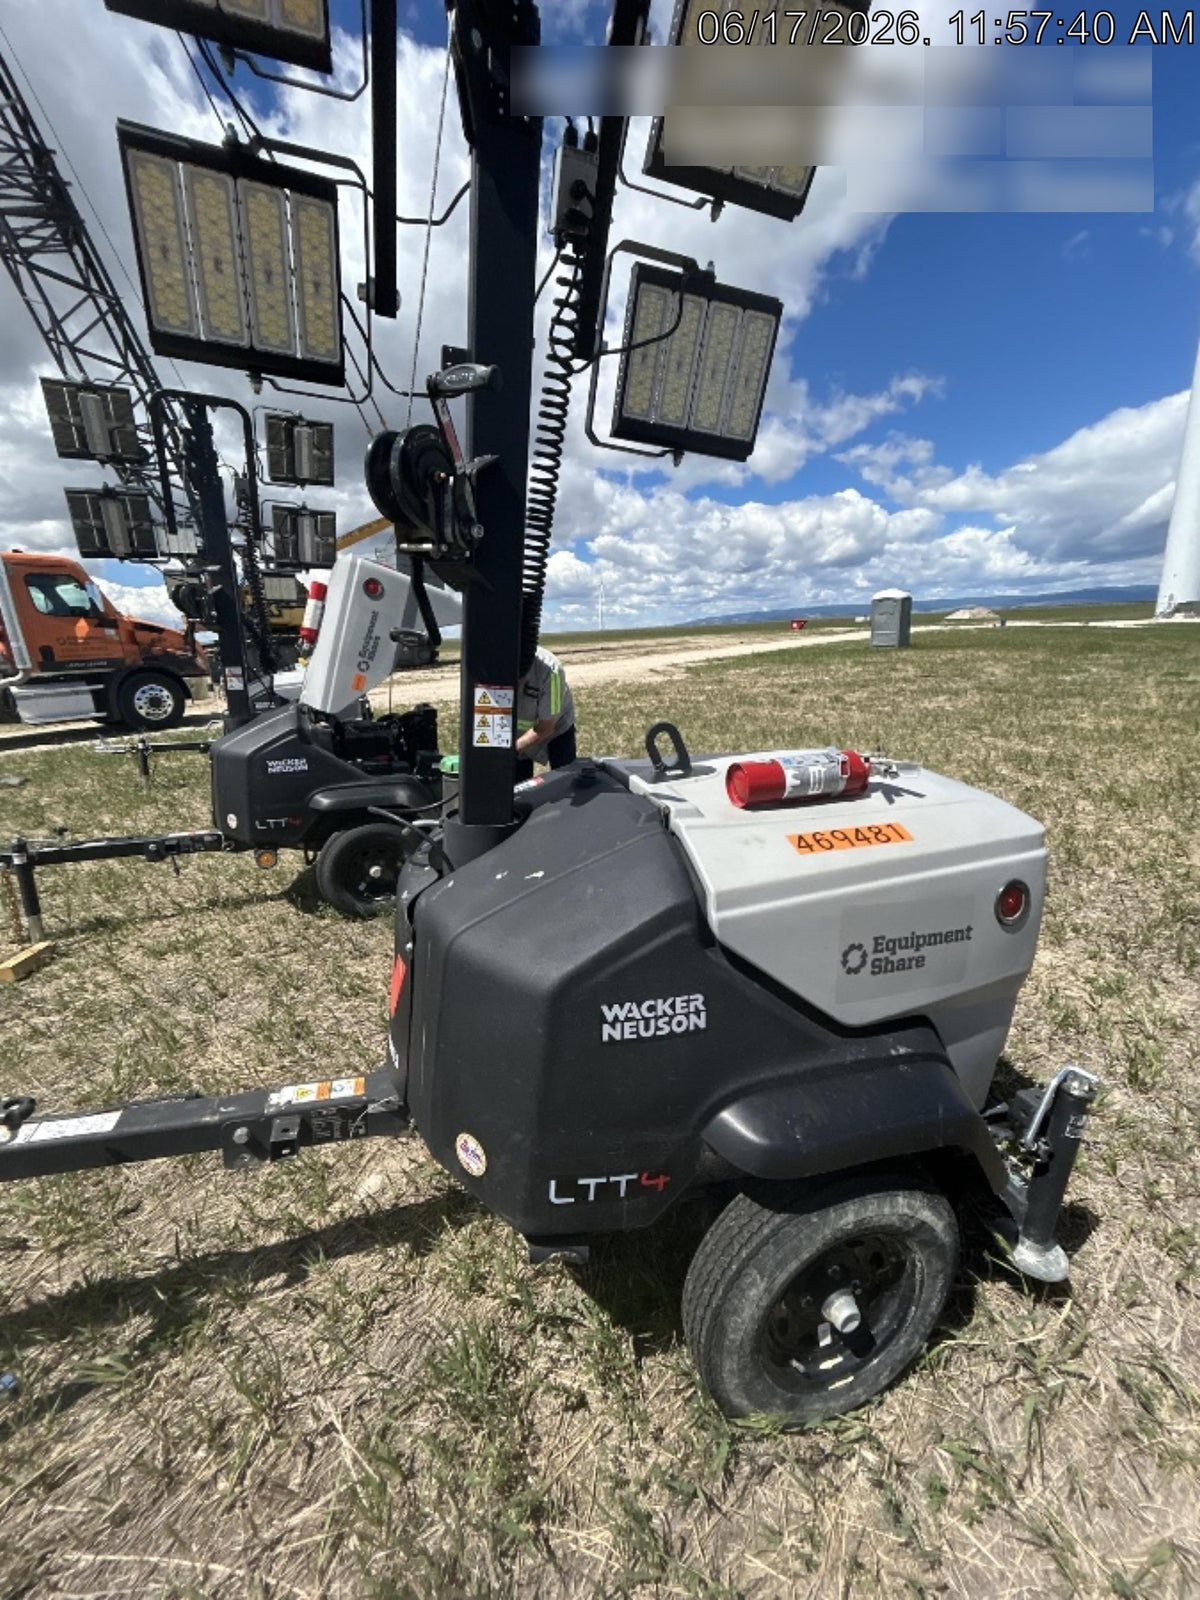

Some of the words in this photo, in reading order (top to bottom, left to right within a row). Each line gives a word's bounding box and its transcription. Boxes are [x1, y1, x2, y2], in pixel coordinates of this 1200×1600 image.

[797, 823, 905, 852] 469481
[872, 924, 974, 955] Equipment
[870, 955, 926, 976] Share
[600, 993, 707, 1023] WACKER
[601, 1011, 707, 1042] NEUSON
[548, 1171, 671, 1204] LTT4
